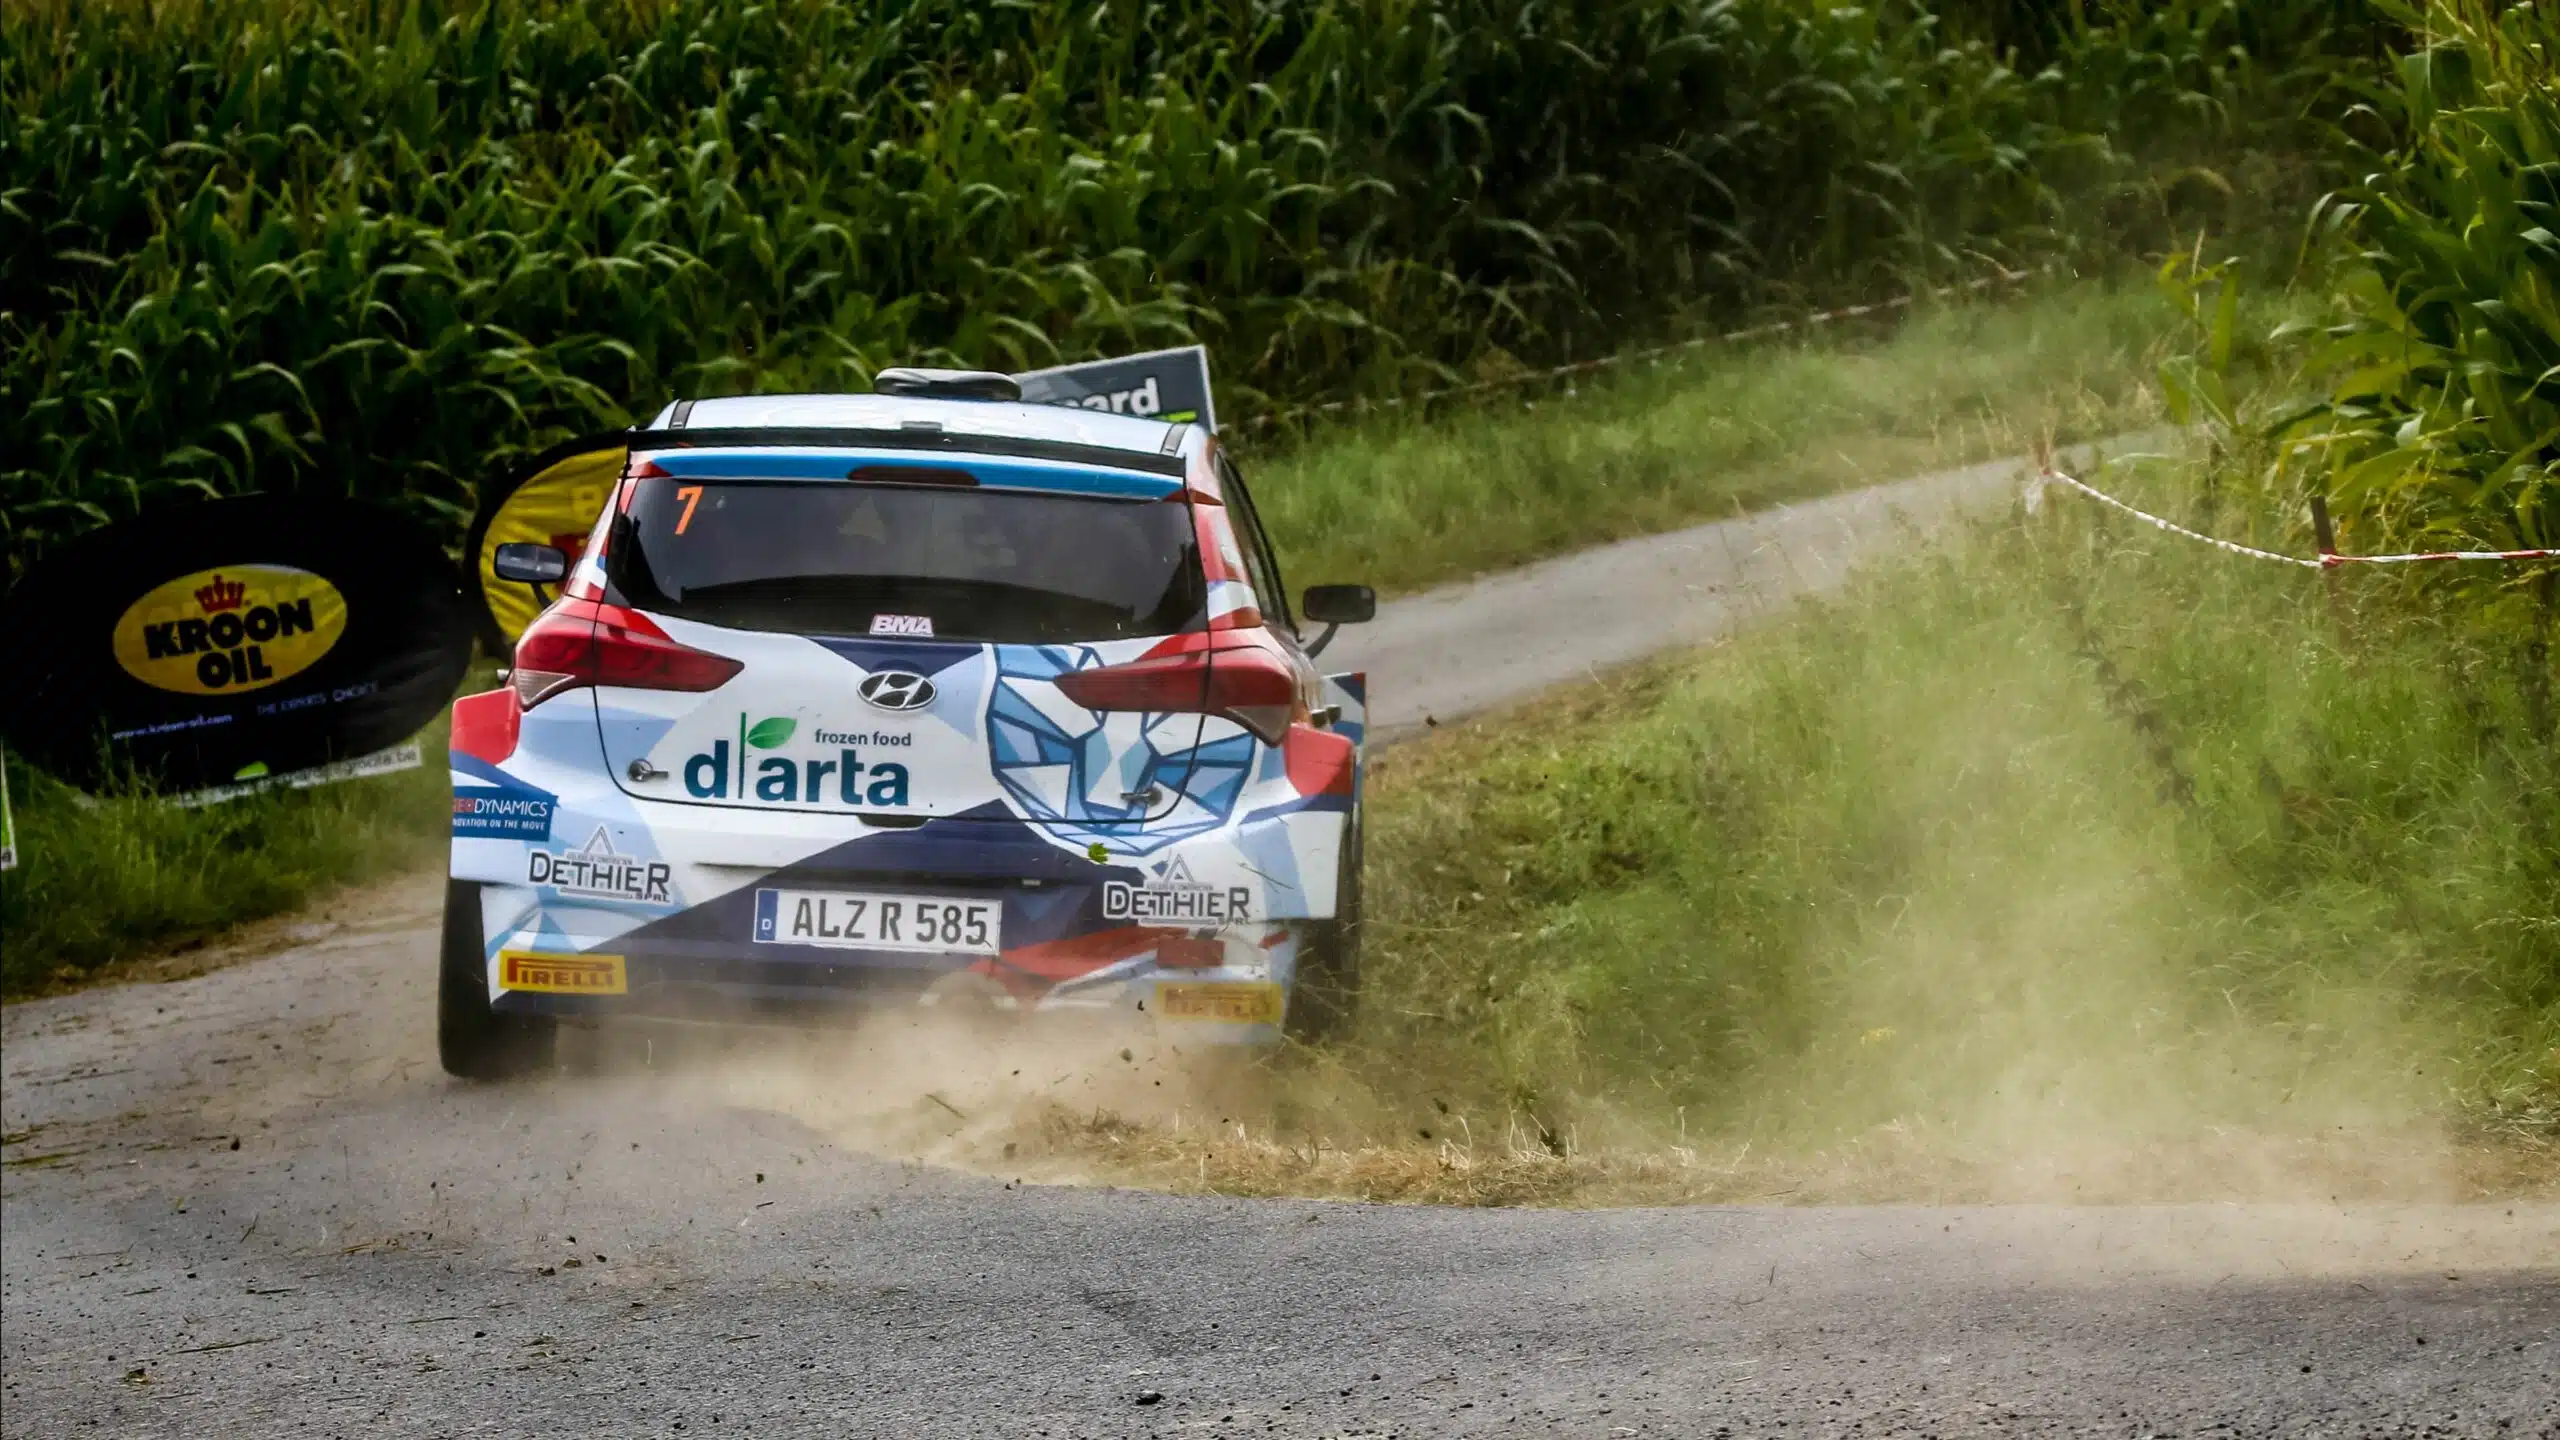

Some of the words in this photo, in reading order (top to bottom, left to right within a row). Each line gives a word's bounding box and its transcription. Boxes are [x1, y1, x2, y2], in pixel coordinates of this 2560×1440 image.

[675, 486, 703, 536] 7
[144, 597, 314, 659] KROON
[873, 614, 933, 635] BMA
[197, 645, 272, 688] OIL
[815, 729, 868, 745] frozen
[872, 731, 911, 746] food
[489, 819, 501, 829] ON
[504, 819, 518, 830] THE
[522, 820, 546, 832] MOVE
[529, 851, 671, 896] DETHIER
[1106, 884, 1250, 918] DETHIER
[762, 918, 772, 931] D
[792, 898, 867, 938] ALZ
[879, 902, 902, 940] R
[916, 903, 989, 945] 585
[507, 957, 615, 987] PIRELLI
